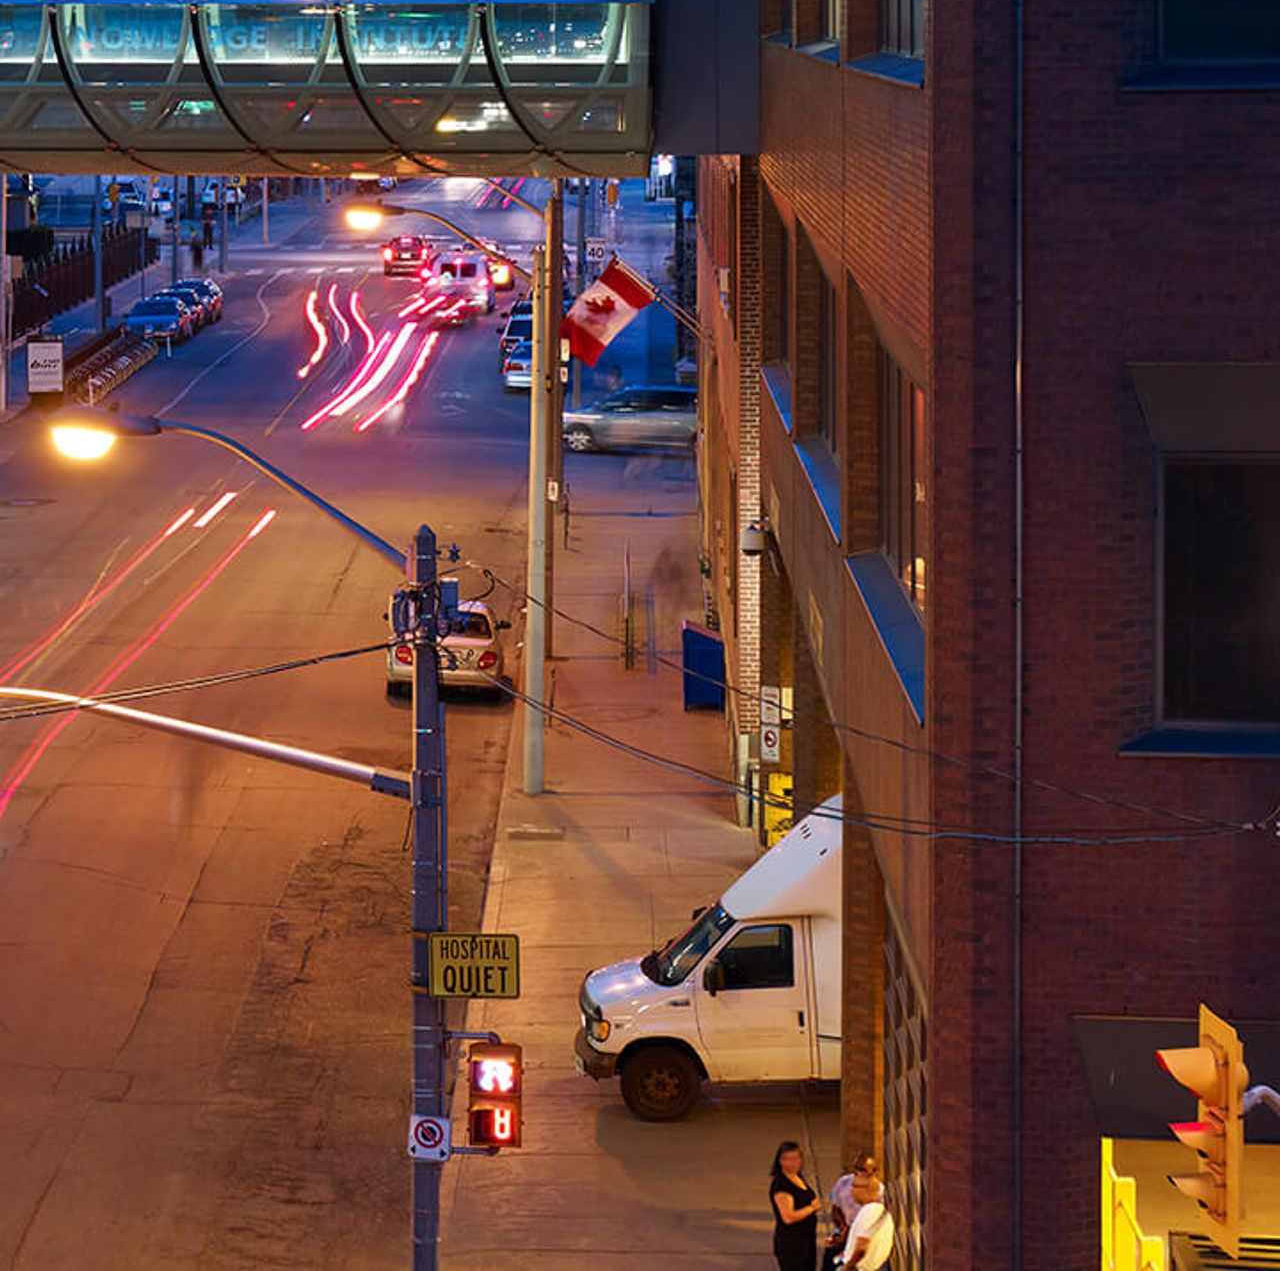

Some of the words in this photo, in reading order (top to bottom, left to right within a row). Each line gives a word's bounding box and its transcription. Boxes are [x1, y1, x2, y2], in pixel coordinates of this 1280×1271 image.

[588, 247, 604, 259] 40
[440, 939, 510, 960] HOSPITAL
[443, 965, 509, 993] QUIET
